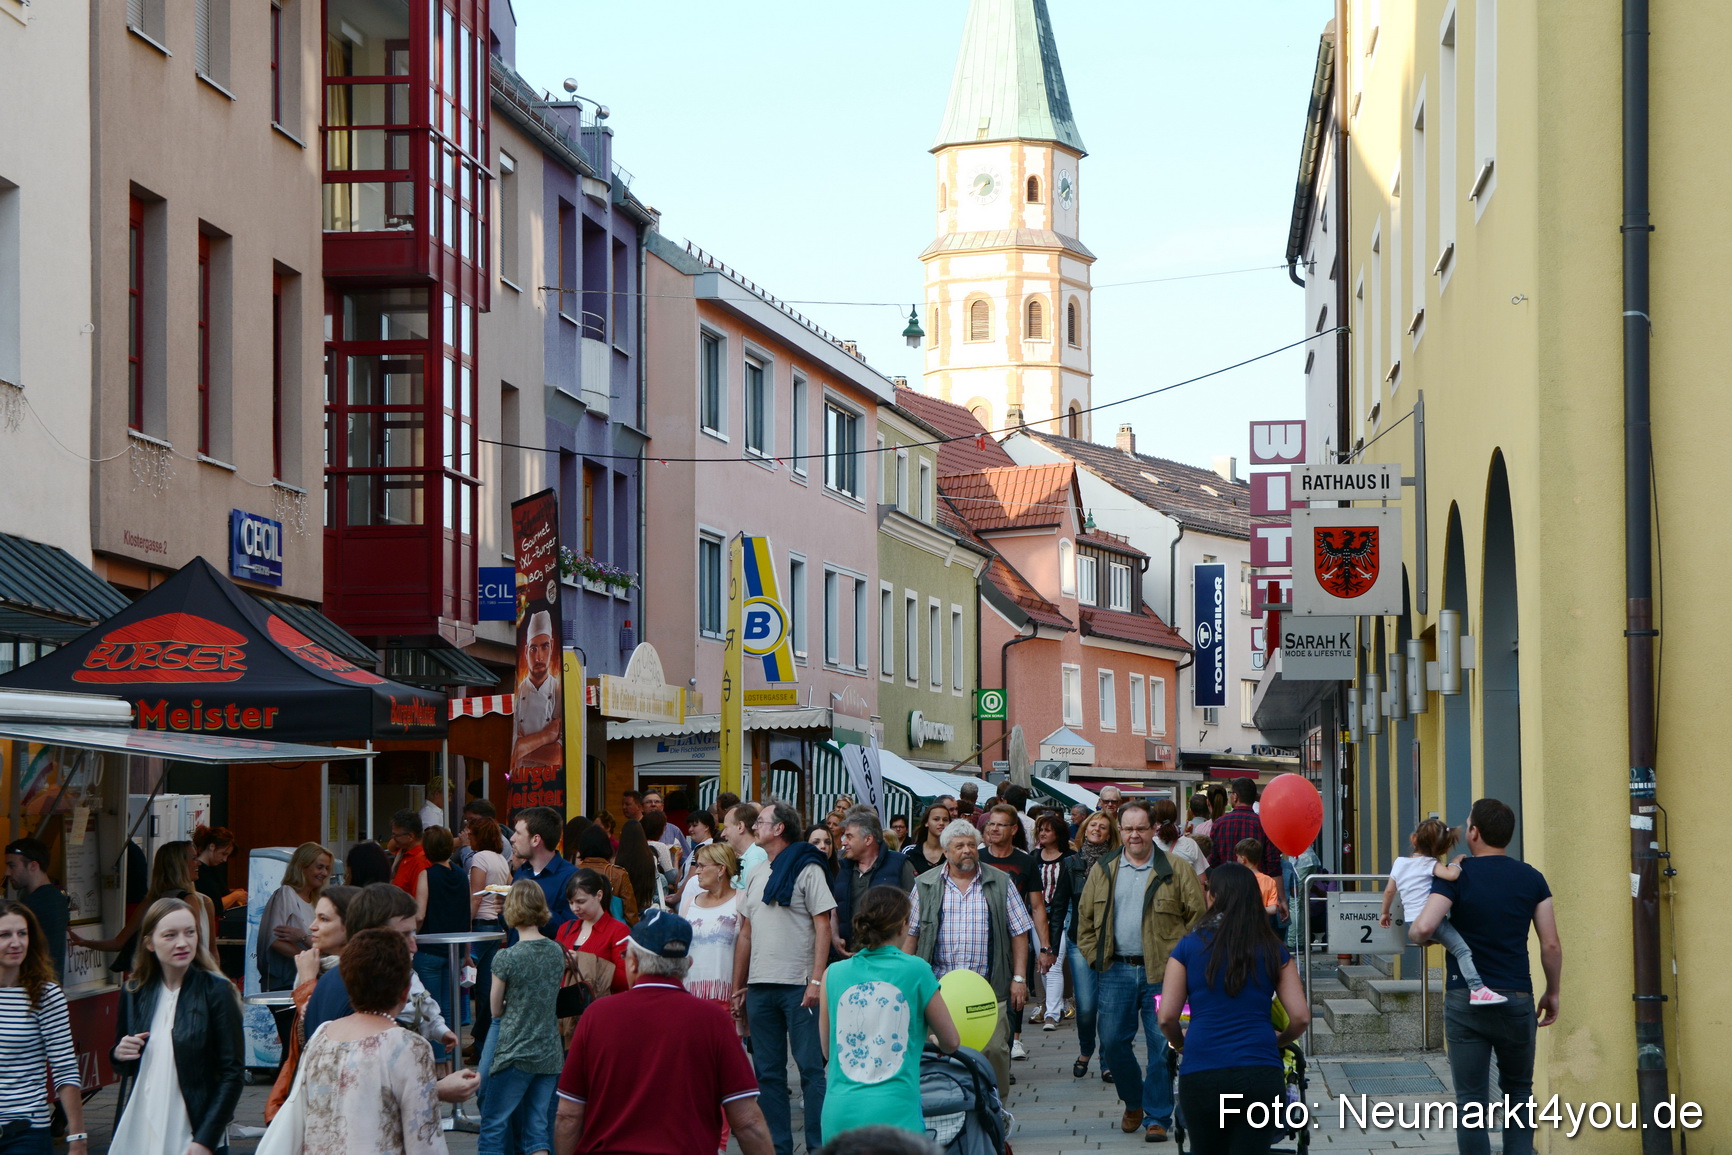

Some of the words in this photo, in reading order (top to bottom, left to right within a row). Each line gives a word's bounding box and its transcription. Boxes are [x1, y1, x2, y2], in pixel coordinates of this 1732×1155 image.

[1302, 474, 1377, 490] RATHAUS
[1381, 474, 1390, 489] II
[123, 529, 163, 554] Klostergasse
[162, 540, 168, 554] 2
[240, 518, 282, 562] CECIL
[521, 521, 551, 551] Gourmet
[477, 583, 514, 599] ECIL
[1214, 576, 1223, 643] TAILOR
[744, 611, 771, 640] B
[1285, 632, 1336, 650] SARAH
[1340, 632, 1352, 649] K
[83, 641, 248, 670] BURGER
[1214, 645, 1223, 694] TOM
[132, 699, 280, 731] Meister
[511, 764, 560, 790] urger
[507, 785, 564, 809] eister
[1340, 912, 1392, 921] RATHAUSPLZ
[1360, 925, 1373, 943] 2
